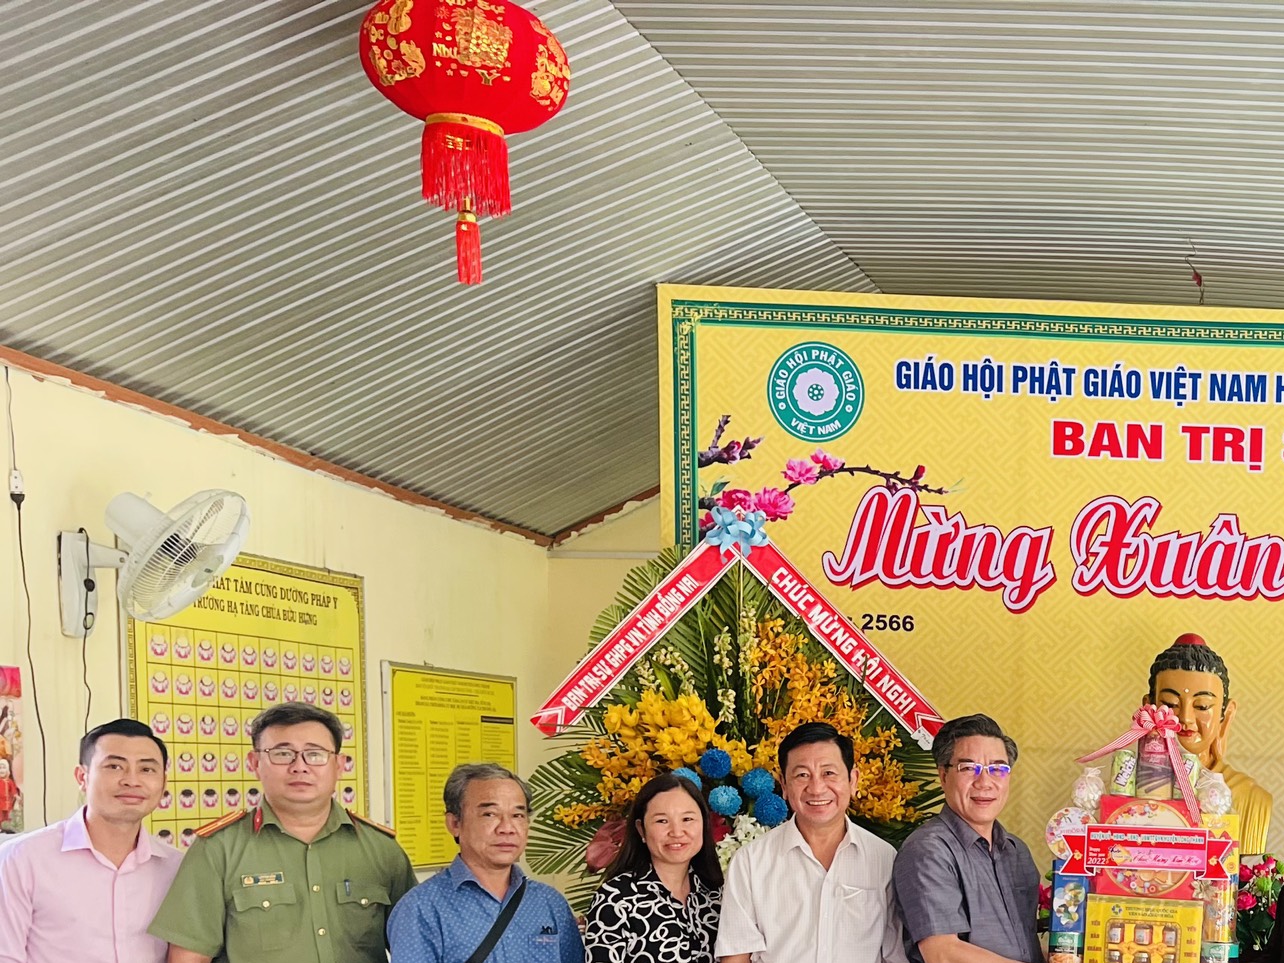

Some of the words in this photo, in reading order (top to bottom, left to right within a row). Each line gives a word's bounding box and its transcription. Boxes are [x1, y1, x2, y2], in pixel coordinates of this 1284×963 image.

[774, 369, 789, 400] GIÁO
[785, 350, 809, 370] HỘI
[811, 349, 845, 369] PHẬT
[841, 370, 859, 402] GIÁO
[896, 356, 954, 391] GIÁO
[962, 357, 1004, 399] HỘI
[1012, 361, 1077, 402] PHẬT
[1083, 363, 1142, 399] GIÁO
[1150, 366, 1202, 407] VIỆT
[1209, 373, 1267, 403] NAM
[790, 417, 816, 435] VIỆT
[817, 419, 842, 436] NAM
[1052, 421, 1163, 460] BAN
[1181, 425, 1263, 471] TRỊ
[822, 485, 1057, 614] Mừng
[676, 574, 700, 596] NAI
[311, 589, 331, 608] PHÁP
[636, 610, 664, 635] TỈNH
[861, 613, 915, 632] 2566
[625, 627, 648, 647] VN
[771, 566, 815, 611] CHÚC
[807, 602, 858, 655] MỪNG
[876, 674, 917, 717] NGHỊ
[604, 638, 635, 669] GHPG
[561, 686, 589, 712] BAN
[1087, 857, 1106, 865] 2022
